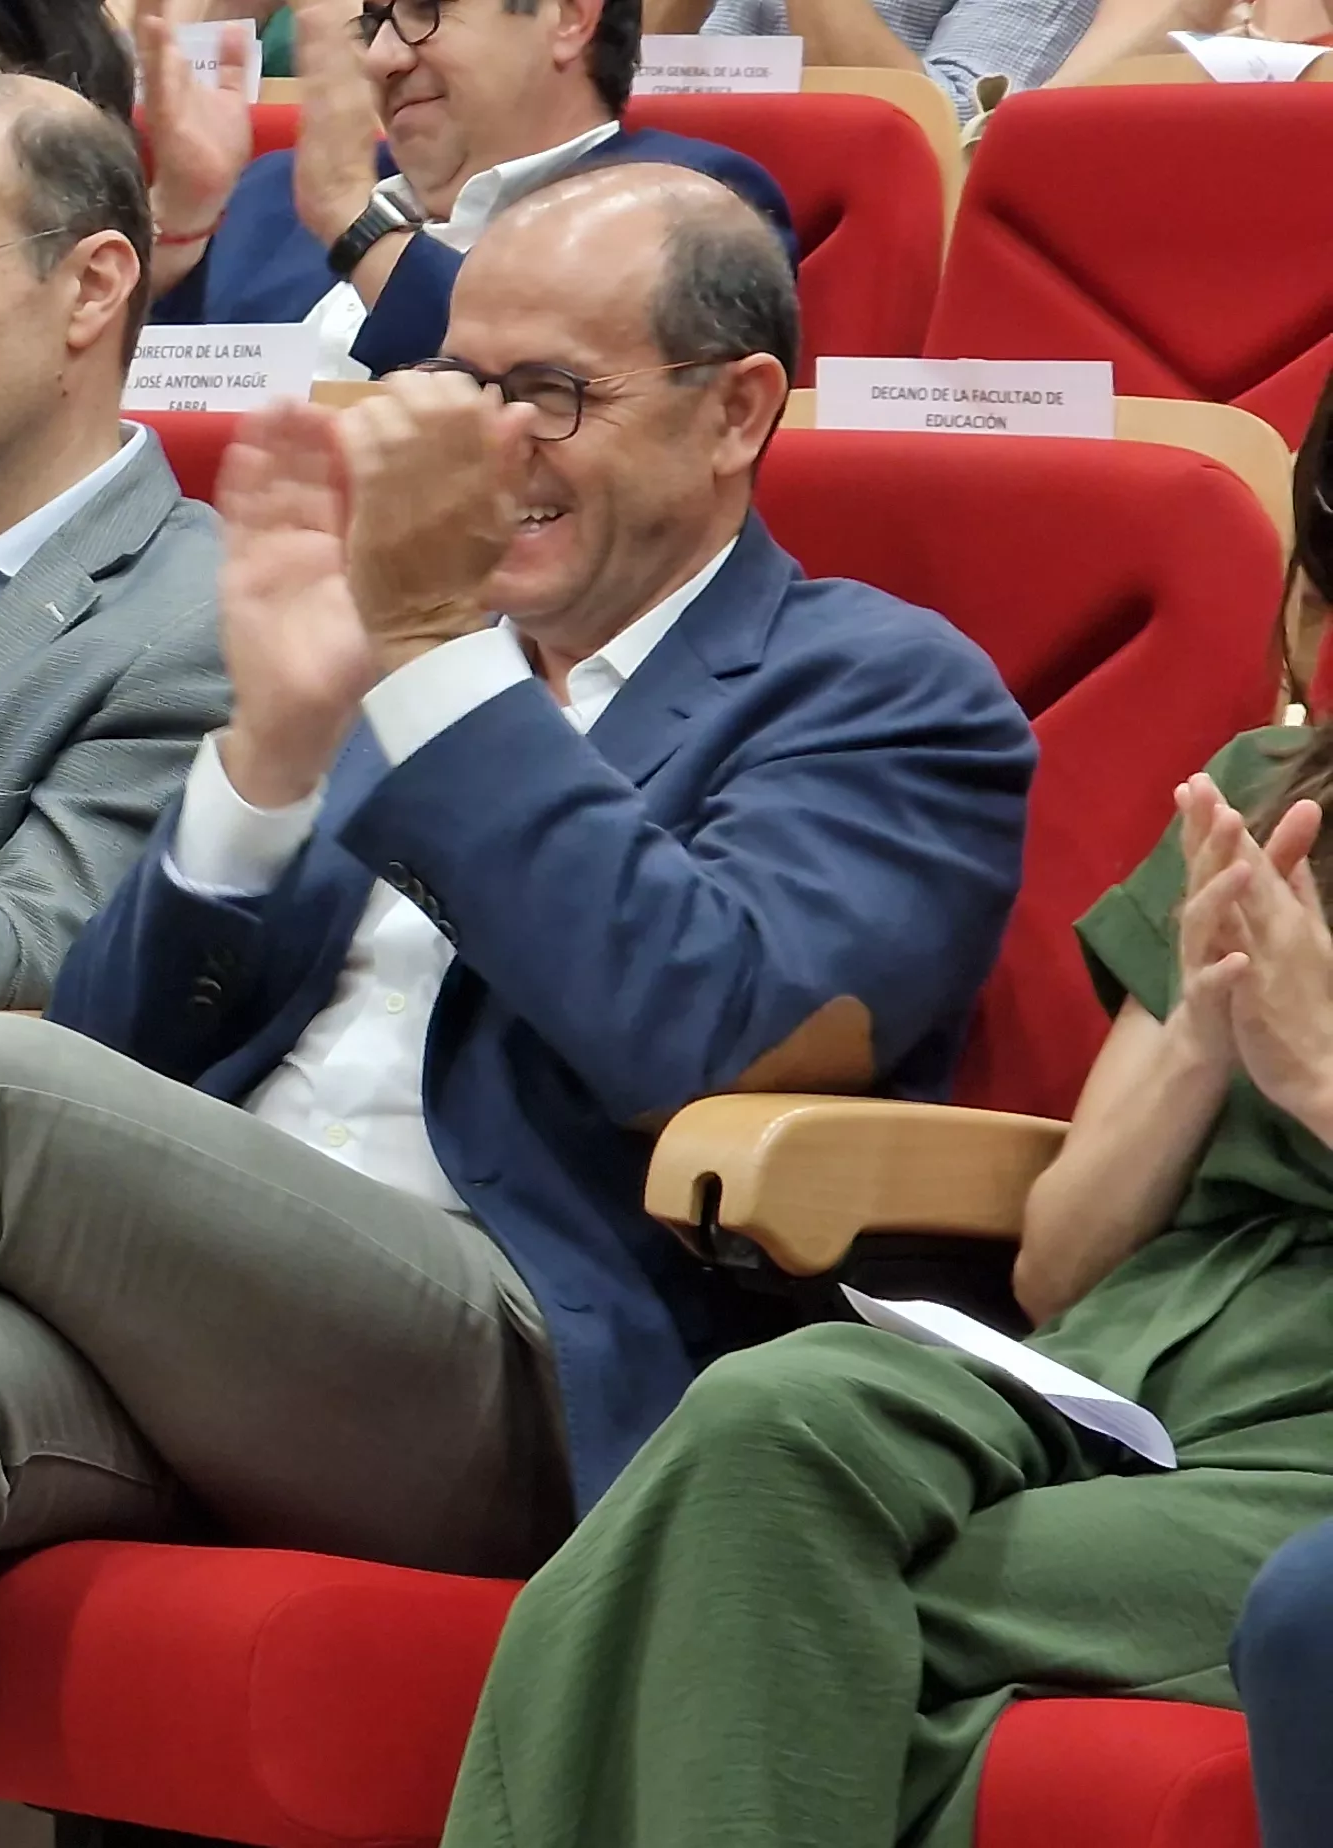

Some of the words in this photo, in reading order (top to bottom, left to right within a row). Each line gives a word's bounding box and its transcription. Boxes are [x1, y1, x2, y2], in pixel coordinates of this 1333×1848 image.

[667, 66, 710, 77] GENERAL
[714, 66, 726, 77] DE
[729, 67, 742, 77] LA
[132, 345, 193, 359] DIRECTOR
[196, 345, 211, 358] DE
[215, 345, 230, 358] LA
[233, 344, 262, 358] EINA
[134, 374, 162, 389] JOSÉ
[164, 374, 223, 389] ANTONIO
[226, 371, 268, 388] YAGÜE
[871, 385, 928, 401] DECANO
[932, 386, 950, 401] DE
[953, 388, 968, 402] LA
[971, 388, 1042, 405] FACULTAD
[1046, 391, 1064, 405] DE
[925, 412, 1007, 429] EDUCACIÓN
